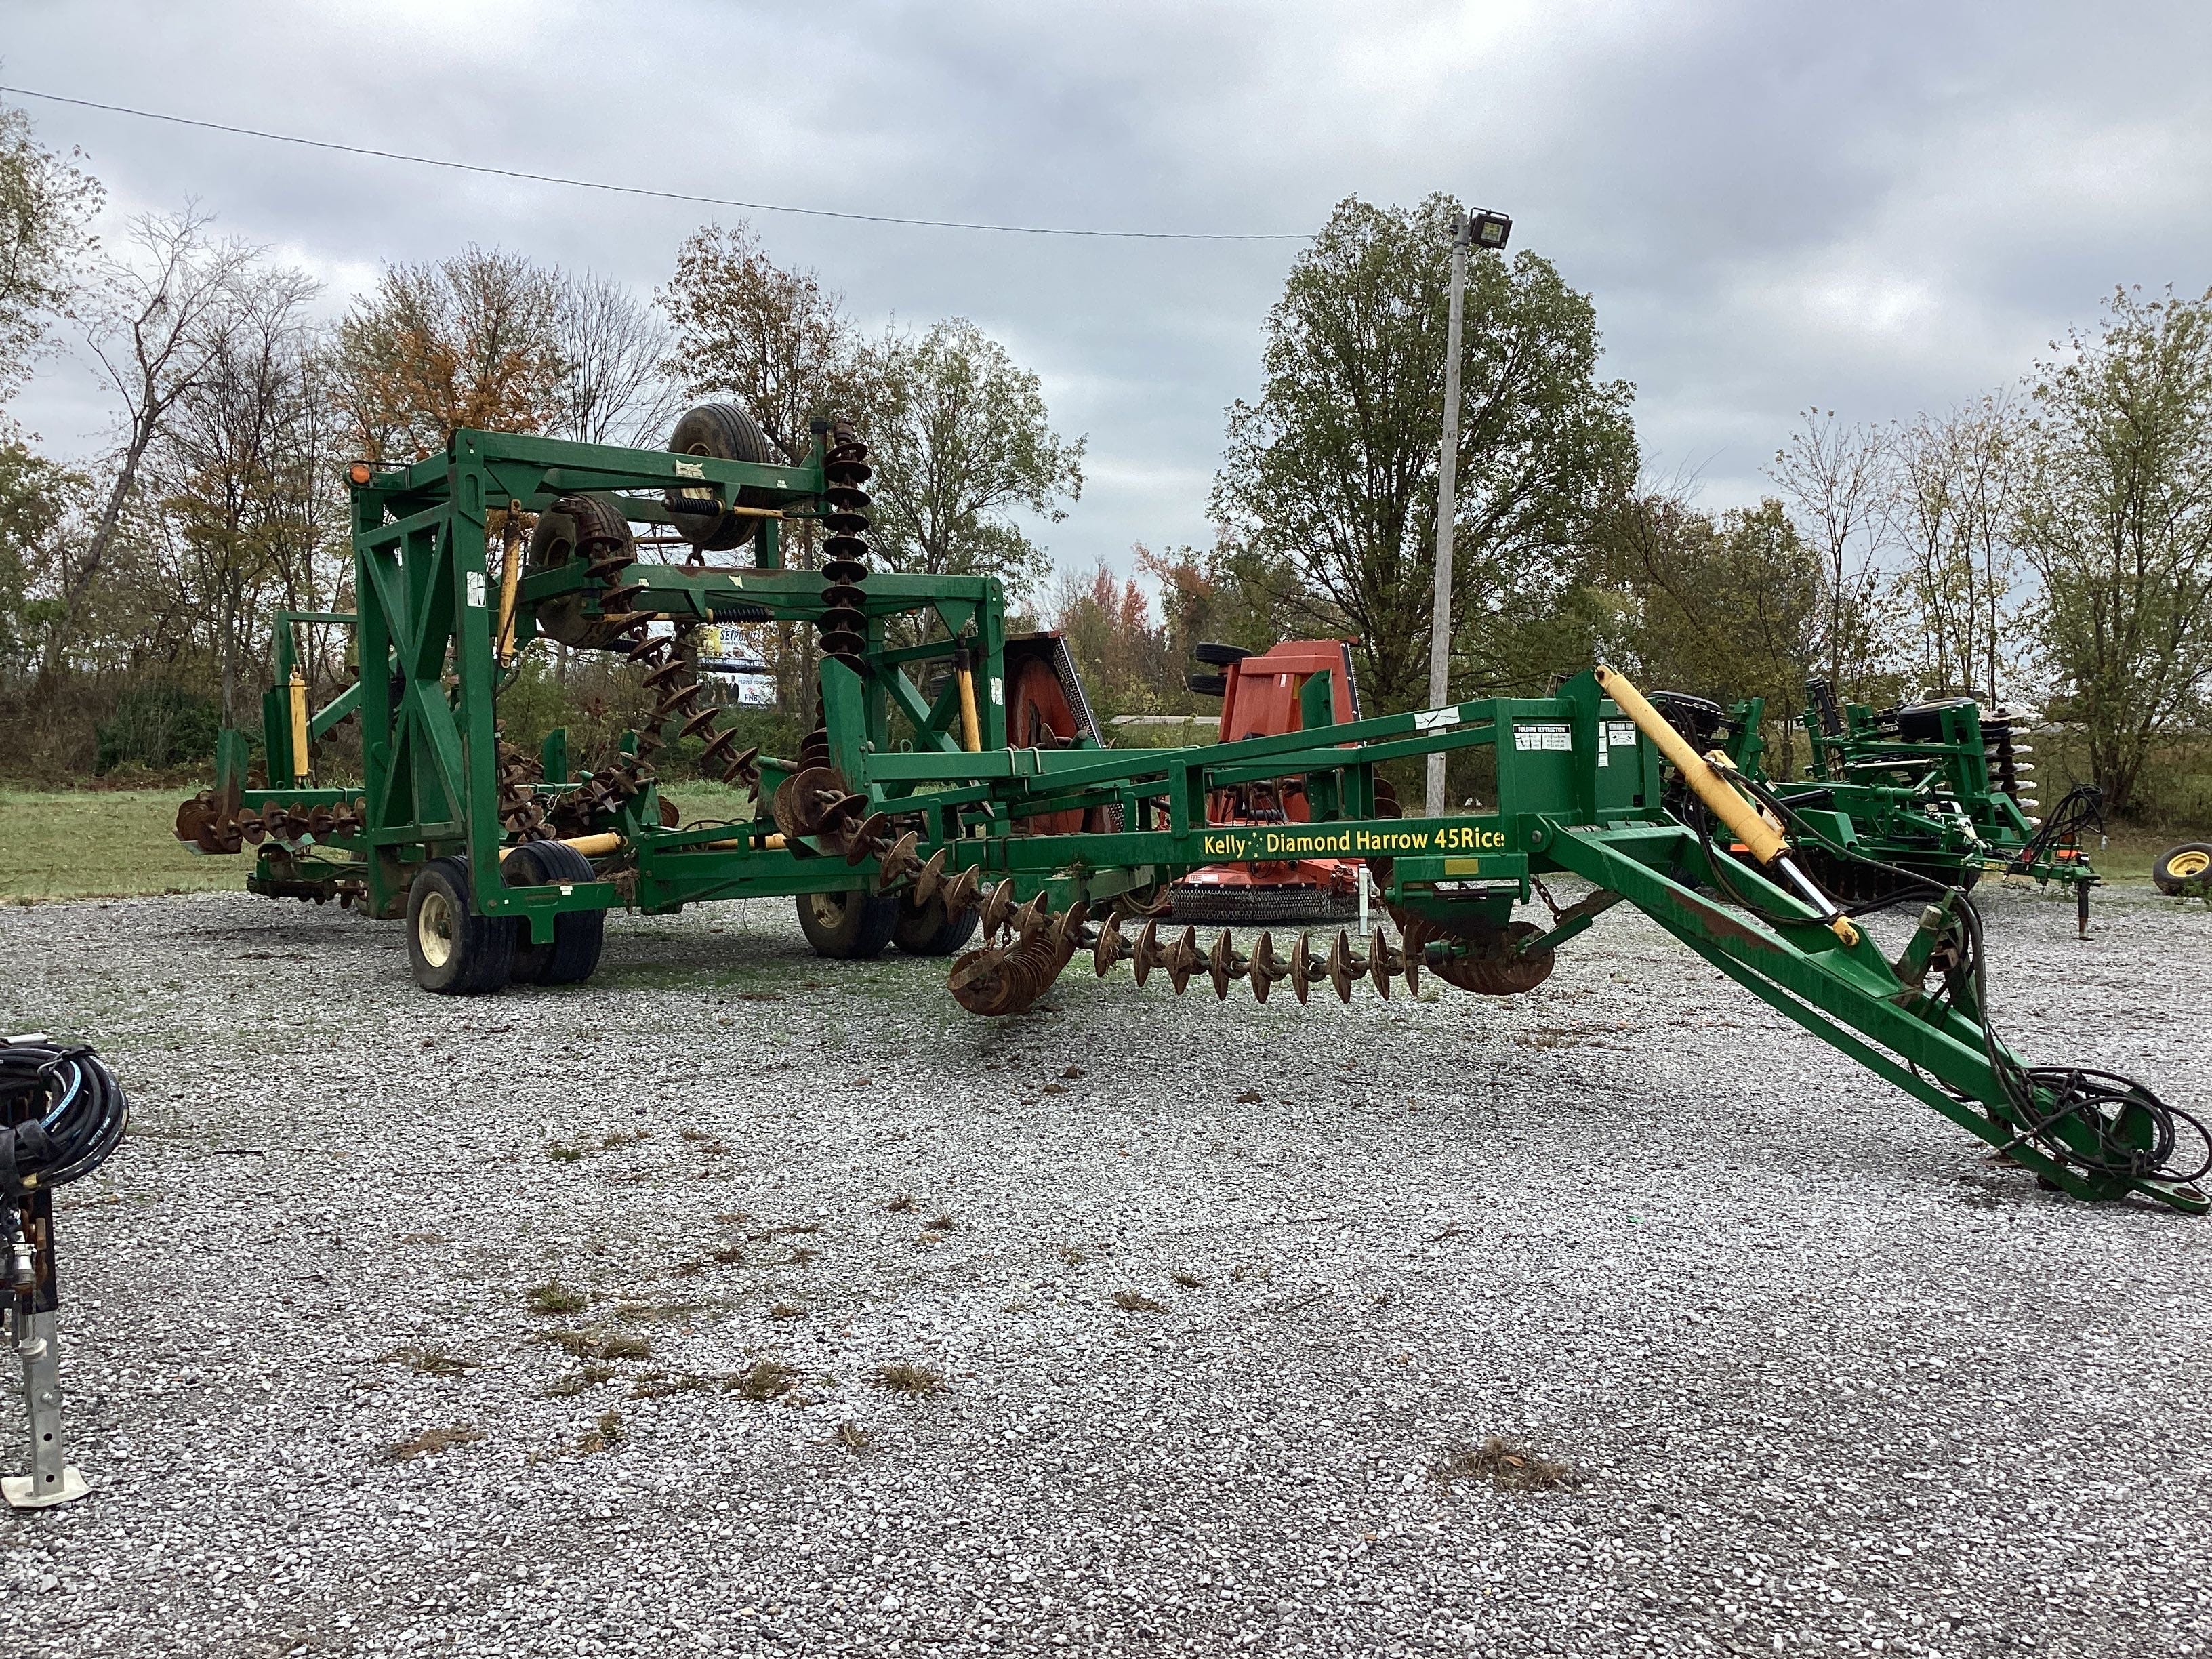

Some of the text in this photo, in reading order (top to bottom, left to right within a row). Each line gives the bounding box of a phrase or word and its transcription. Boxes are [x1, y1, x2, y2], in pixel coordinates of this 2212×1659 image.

[745, 694, 758, 702] FNB
[1204, 827, 1504, 858] Kelly Diamond Harrow 45Rice
